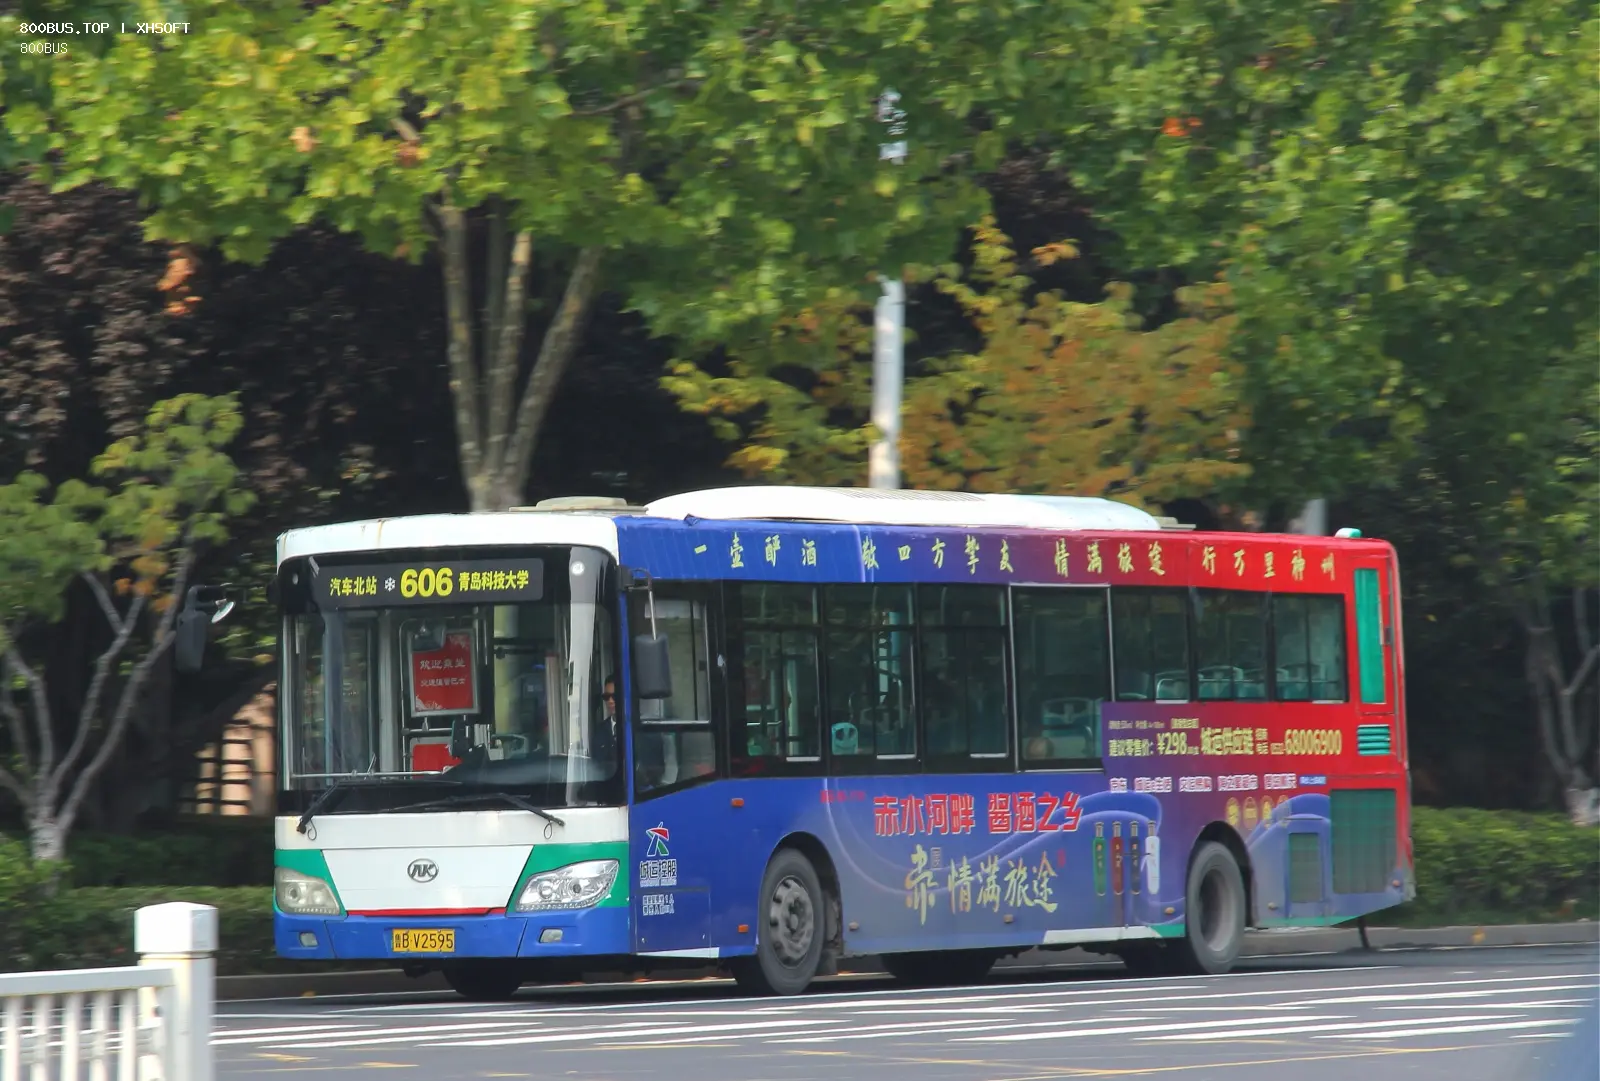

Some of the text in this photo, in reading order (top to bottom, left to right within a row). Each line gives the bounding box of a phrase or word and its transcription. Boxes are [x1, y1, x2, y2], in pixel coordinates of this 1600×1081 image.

[329, 567, 530, 599] 汽车北站 606 青岛科技大学
[1284, 729, 1343, 756] 68006900
[873, 791, 1084, 837] 赤水河畔 酱酒之乡
